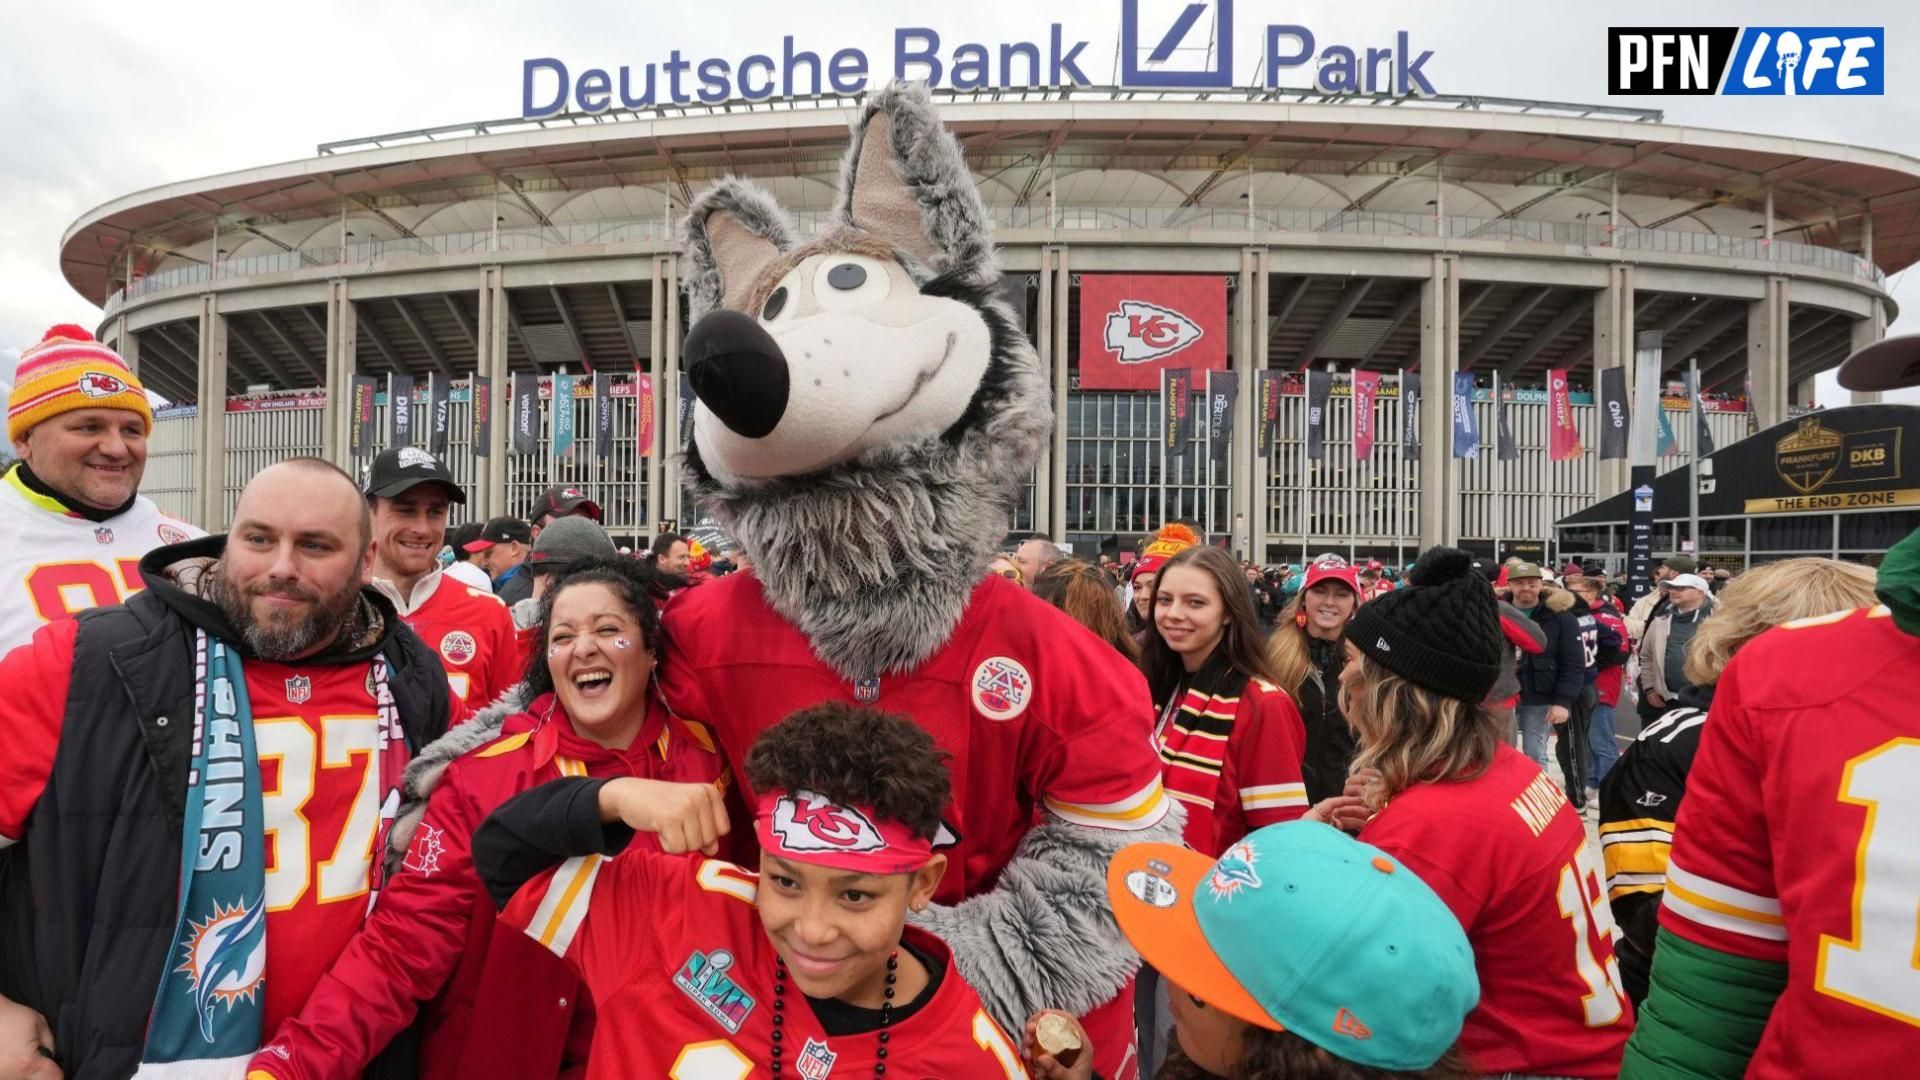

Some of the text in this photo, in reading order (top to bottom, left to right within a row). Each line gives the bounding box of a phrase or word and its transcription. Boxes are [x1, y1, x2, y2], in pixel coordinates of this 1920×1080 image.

[522, 23, 1437, 120] Deutsche Bank Park
[1128, 315, 1179, 348] KC
[298, 398, 326, 407] PATRIOT
[396, 396, 408, 425] DKB
[436, 400, 447, 432] VISA
[521, 394, 531, 433] verizon
[1211, 394, 1227, 438] DERTOUR
[1310, 407, 1321, 425] DB
[1454, 394, 1462, 423] COLTS
[1555, 392, 1565, 427] CHIEFS
[1608, 400, 1623, 428] Chio
[1780, 452, 1836, 465] FRANKFURT
[1850, 448, 1885, 462] DKB
[1775, 492, 1896, 509] THE END ZONE
[791, 802, 861, 846] KC
[683, 981, 731, 1024] SUPER BOWL
